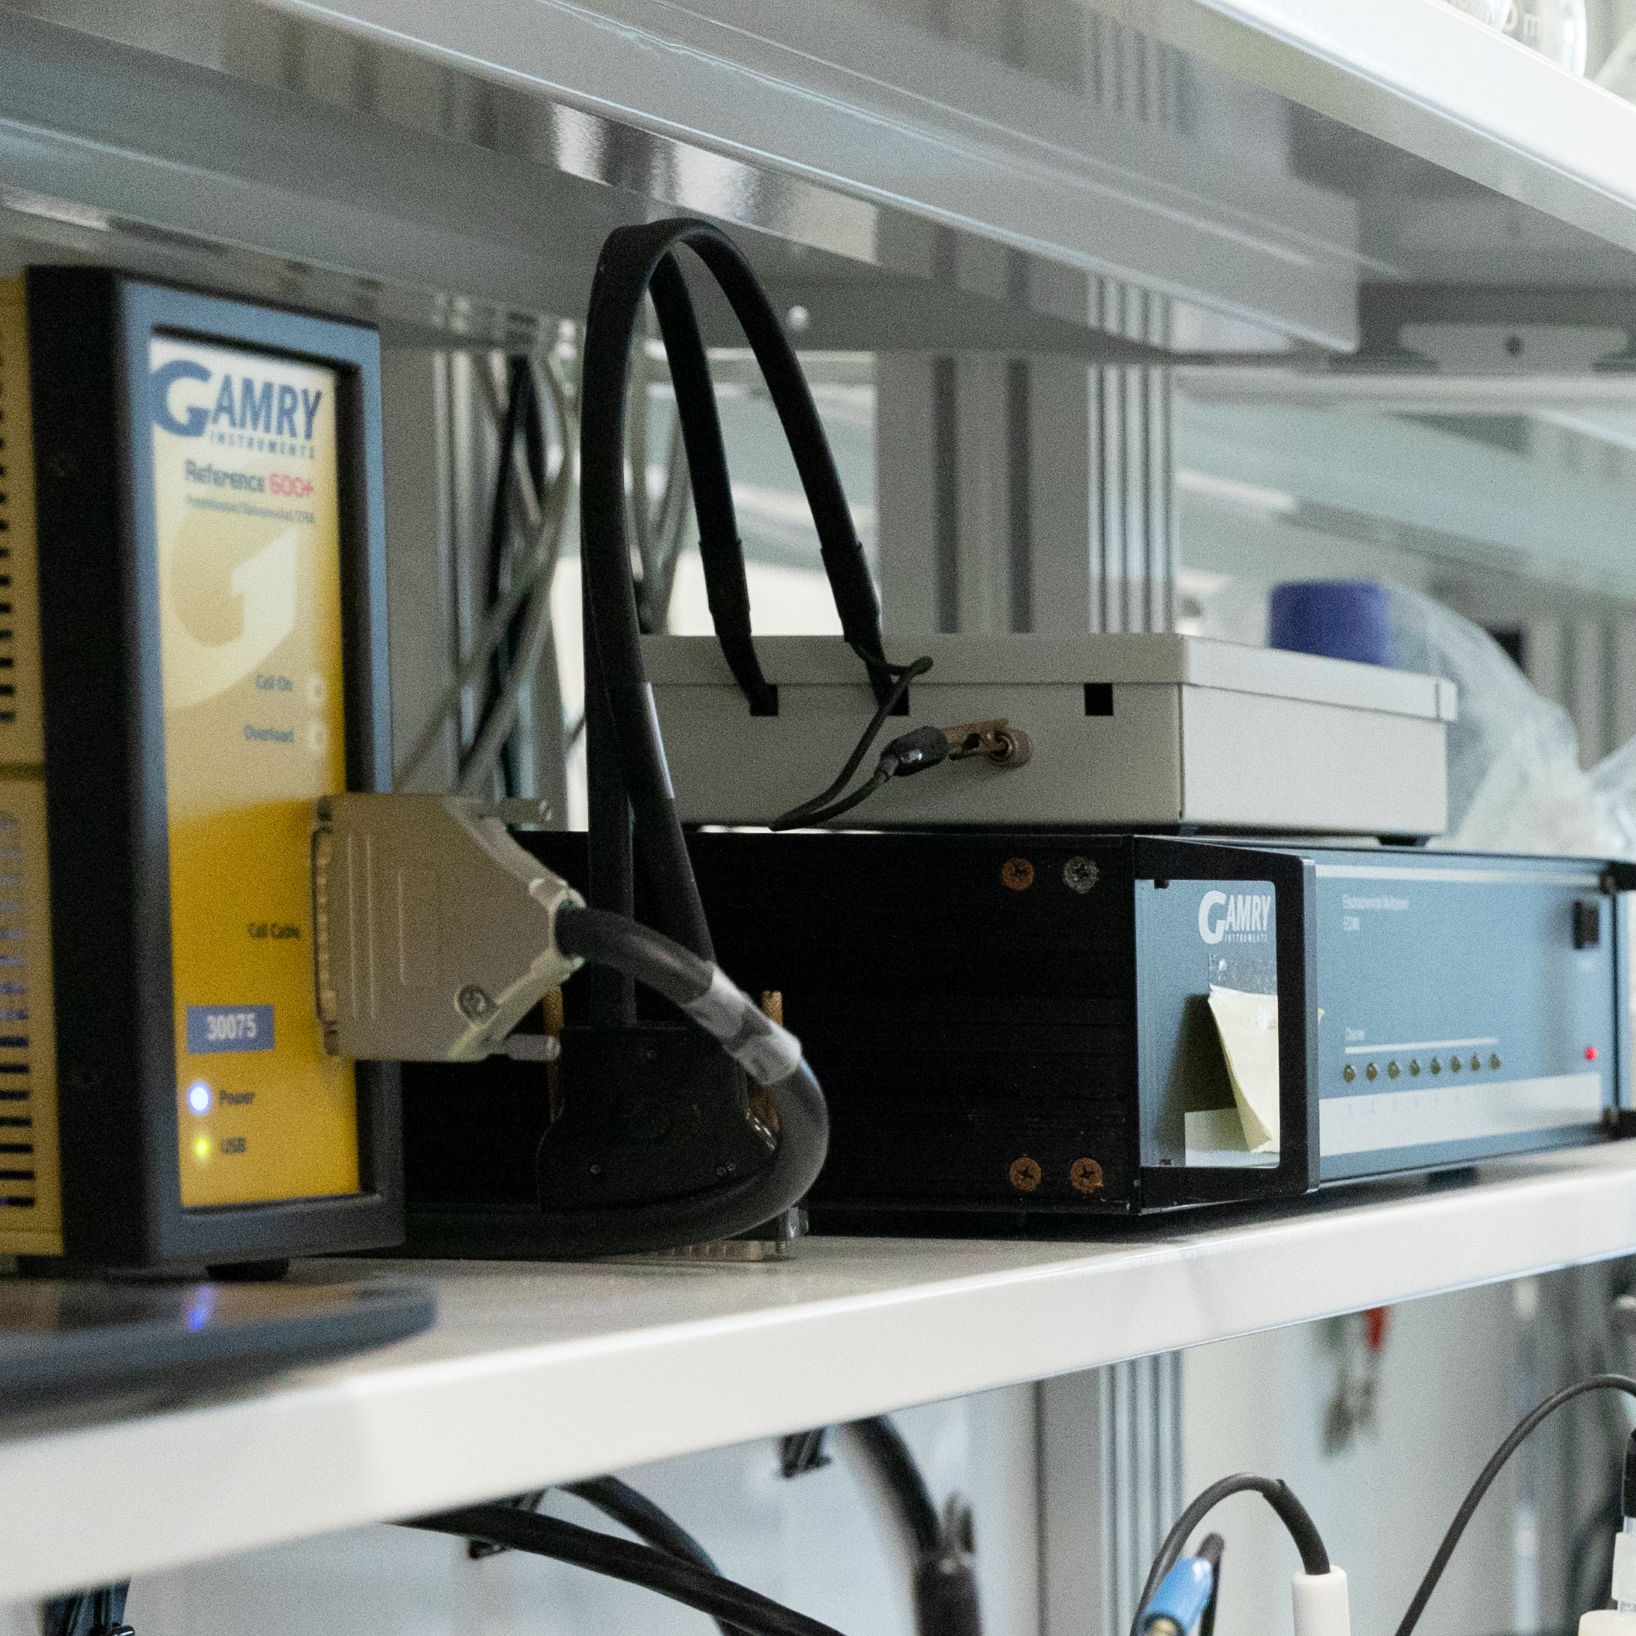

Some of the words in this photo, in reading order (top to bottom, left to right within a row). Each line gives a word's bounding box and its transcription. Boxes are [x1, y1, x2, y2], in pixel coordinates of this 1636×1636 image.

[149, 359, 322, 440] GAMRY
[184, 459, 266, 494] Reference
[1198, 889, 1271, 944] GAMRY
[206, 1012, 257, 1041] 30075
